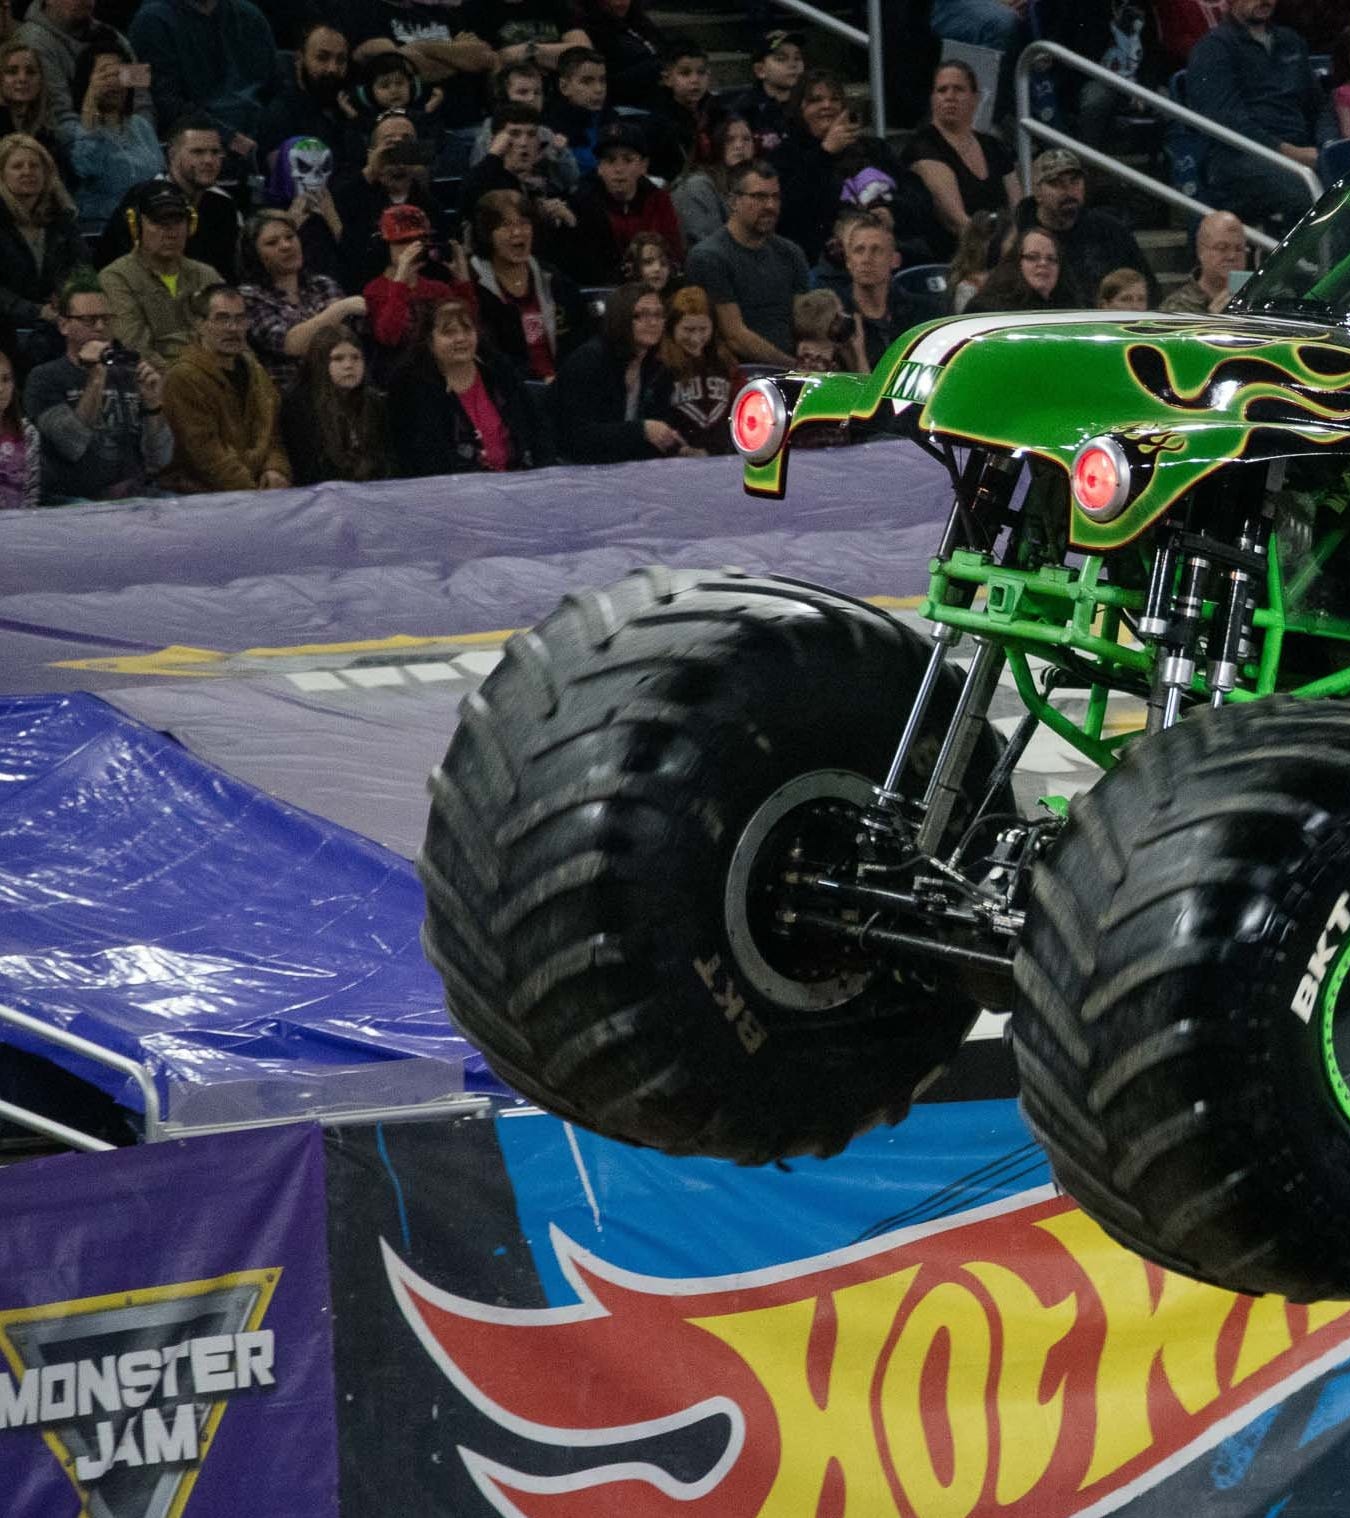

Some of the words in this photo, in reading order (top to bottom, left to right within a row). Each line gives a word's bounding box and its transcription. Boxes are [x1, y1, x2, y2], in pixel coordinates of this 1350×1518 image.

[692, 952, 768, 1057] BKT
[0, 1329, 276, 1430] MONSTER
[690, 1260, 1078, 1518] HOT
[76, 1403, 199, 1481] JAM
